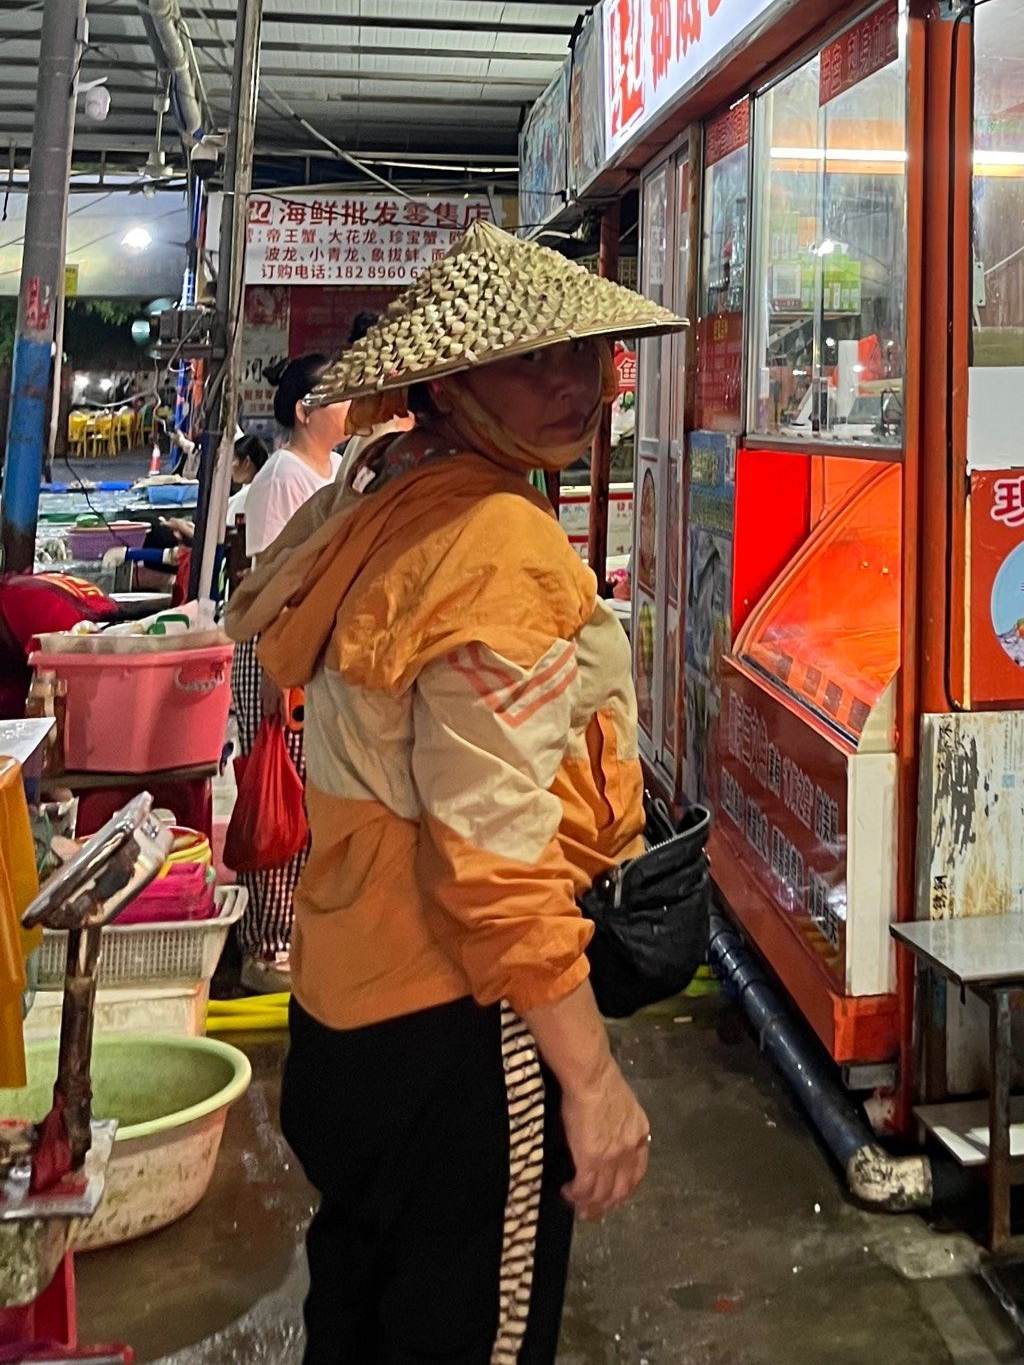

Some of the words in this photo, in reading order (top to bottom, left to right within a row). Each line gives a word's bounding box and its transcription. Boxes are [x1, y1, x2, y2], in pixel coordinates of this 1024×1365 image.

[279, 199, 491, 228] 海鲜批发零售店
[367, 265, 406, 280] 8960
